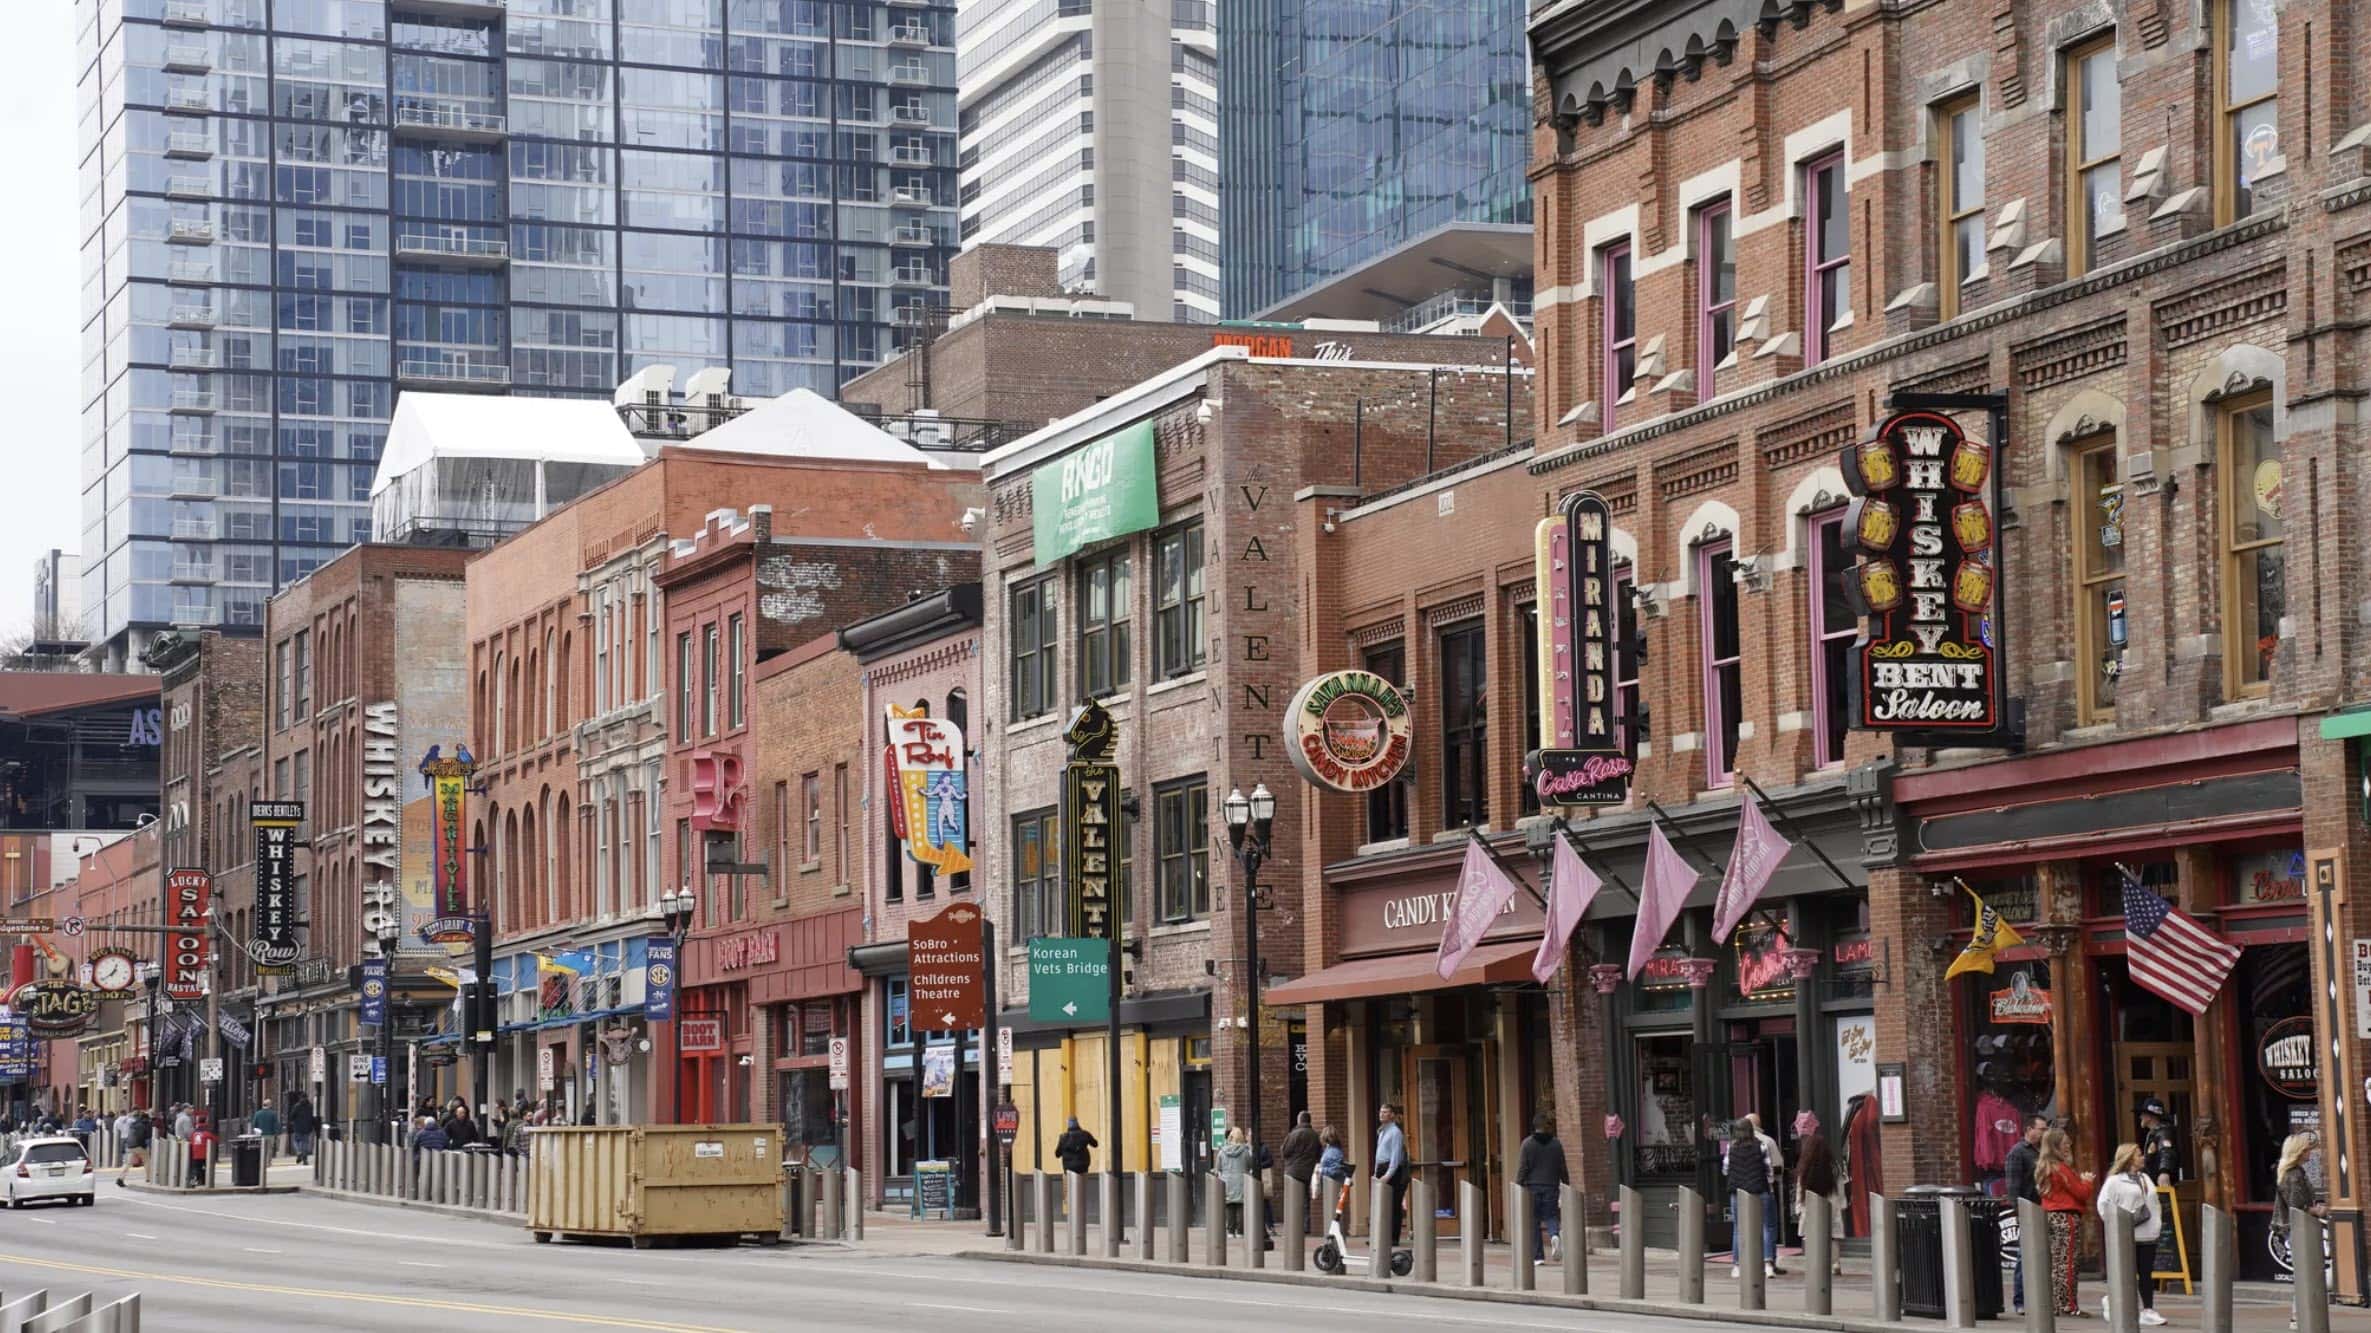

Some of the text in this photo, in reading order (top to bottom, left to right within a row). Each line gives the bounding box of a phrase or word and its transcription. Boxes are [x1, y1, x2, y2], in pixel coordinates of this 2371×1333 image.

[1314, 341, 1354, 360] This
[1901, 426, 1950, 655] WHISKEY
[1579, 512, 1606, 736] MIRANDA
[1873, 662, 1983, 689] BENT
[1208, 488, 1226, 913] VALENTINE
[1239, 485, 1275, 911] VALENTNE
[1873, 688, 1984, 721] Saloon
[903, 720, 946, 743] Tin
[902, 742, 955, 770] Roof
[1302, 734, 1408, 788] CANDY KITCHEN
[363, 702, 398, 868] WHISKEY
[1537, 755, 1633, 796] Casa Rosa
[1080, 780, 1108, 938] VALENTI
[170, 876, 208, 888] LUCKY
[267, 828, 285, 941] WHISKEY
[1384, 893, 1439, 928] CANDY
[253, 939, 296, 964] Row
[648, 951, 673, 960] FANS
[913, 939, 948, 950] SoBro
[1033, 947, 1077, 959] Korean
[1835, 942, 1873, 963] LAM
[914, 952, 980, 964] Attractions
[1034, 962, 1108, 977] Vets Bridge
[1645, 958, 1682, 977] MIRA
[914, 974, 971, 986] Childrens
[915, 988, 961, 1000] Theatre
[682, 1023, 715, 1035] BOOT
[682, 1035, 715, 1047] BARN
[2265, 1035, 2311, 1068] WHISKEY
[2279, 1068, 2320, 1080] SALOO
[2001, 1227, 2020, 1244] SAL
